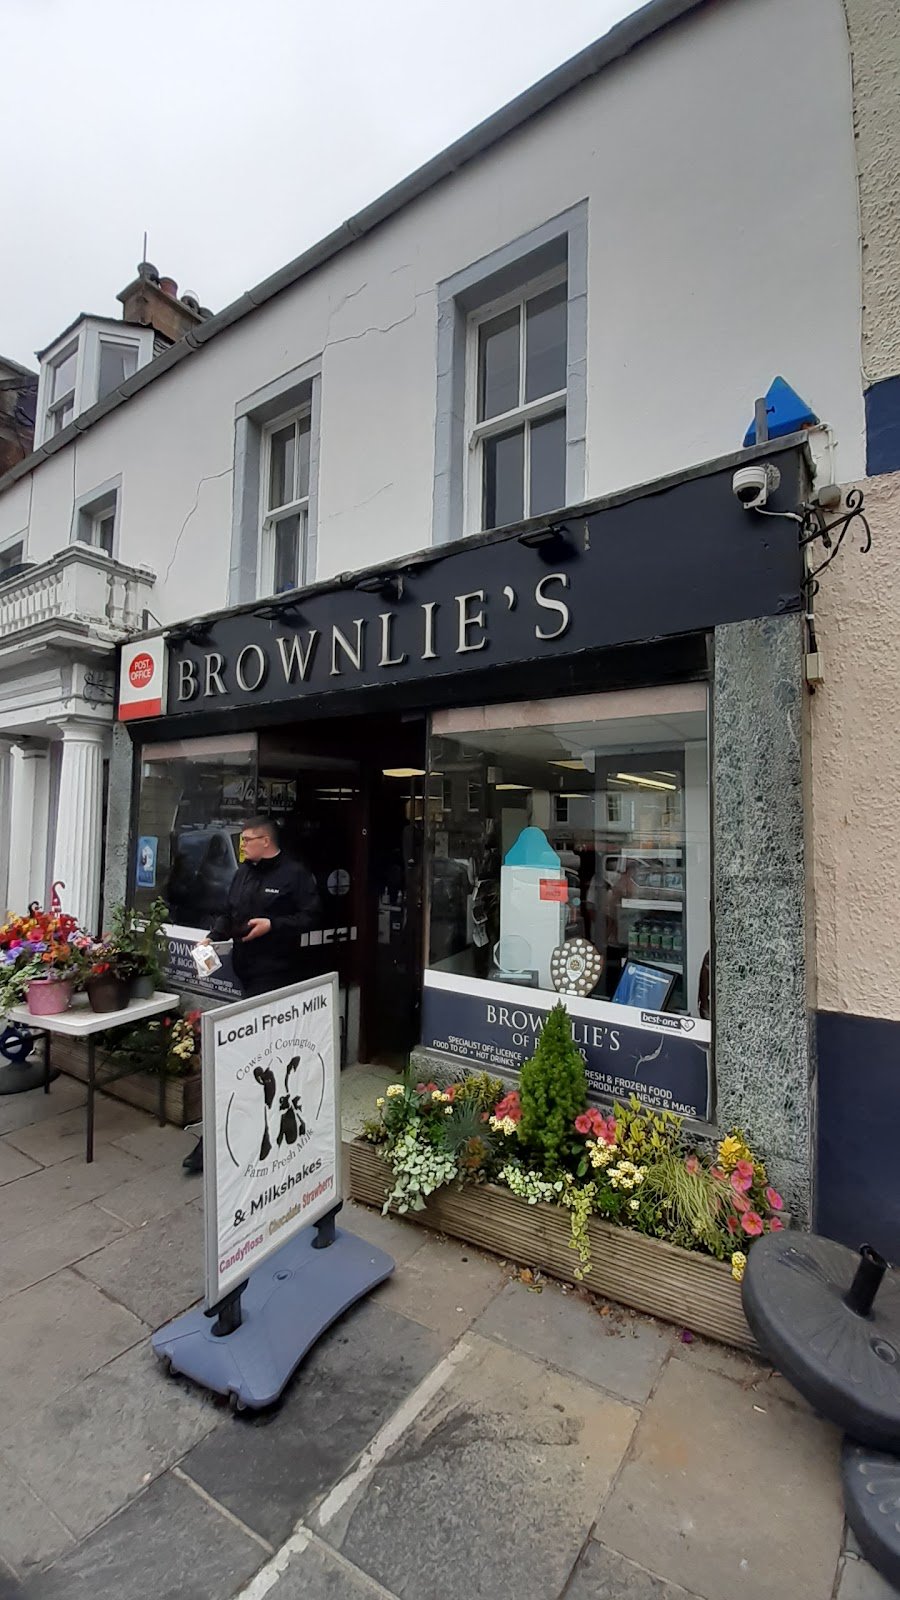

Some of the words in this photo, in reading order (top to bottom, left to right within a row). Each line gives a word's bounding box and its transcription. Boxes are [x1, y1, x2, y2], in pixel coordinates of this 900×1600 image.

[178, 572, 572, 702] BROWNLIE'S
[130, 668, 152, 681] OFFICE
[134, 659, 150, 671] POST
[217, 1018, 257, 1046] Local
[262, 1005, 299, 1030] Fresh
[302, 995, 327, 1015] Milk
[487, 1004, 621, 1051] BROWLIE'S
[512, 1033, 530, 1047] OF
[642, 1012, 678, 1027] best-one
[236, 1055, 262, 1080] Cows
[264, 1042, 272, 1056] of
[275, 1038, 316, 1051] Covington
[432, 1039, 449, 1050] FOOD
[450, 1043, 458, 1052] TO
[459, 1046, 468, 1055] GO
[476, 1051, 489, 1060] HOT
[490, 1054, 515, 1067] DRINKS
[588, 1079, 625, 1096] PRODUCE
[636, 1092, 661, 1106] NEWS
[662, 1099, 670, 1109] &
[671, 1102, 697, 1116] MAGS
[448, 1035, 482, 1050] SPECIALIST
[482, 1043, 496, 1053] OFF
[496, 1047, 522, 1061] LICENCE
[583, 1069, 606, 1082] RESH
[607, 1074, 613, 1084] &
[614, 1076, 647, 1093] FROZEN
[649, 1085, 673, 1100] FOOD
[245, 1164, 268, 1178] Farm
[272, 1150, 296, 1172] Fresh
[233, 1209, 246, 1227] &
[251, 1158, 322, 1215] Milkshakes
[219, 1234, 264, 1273] Candyfloss
[302, 1174, 334, 1208] Strawberry
